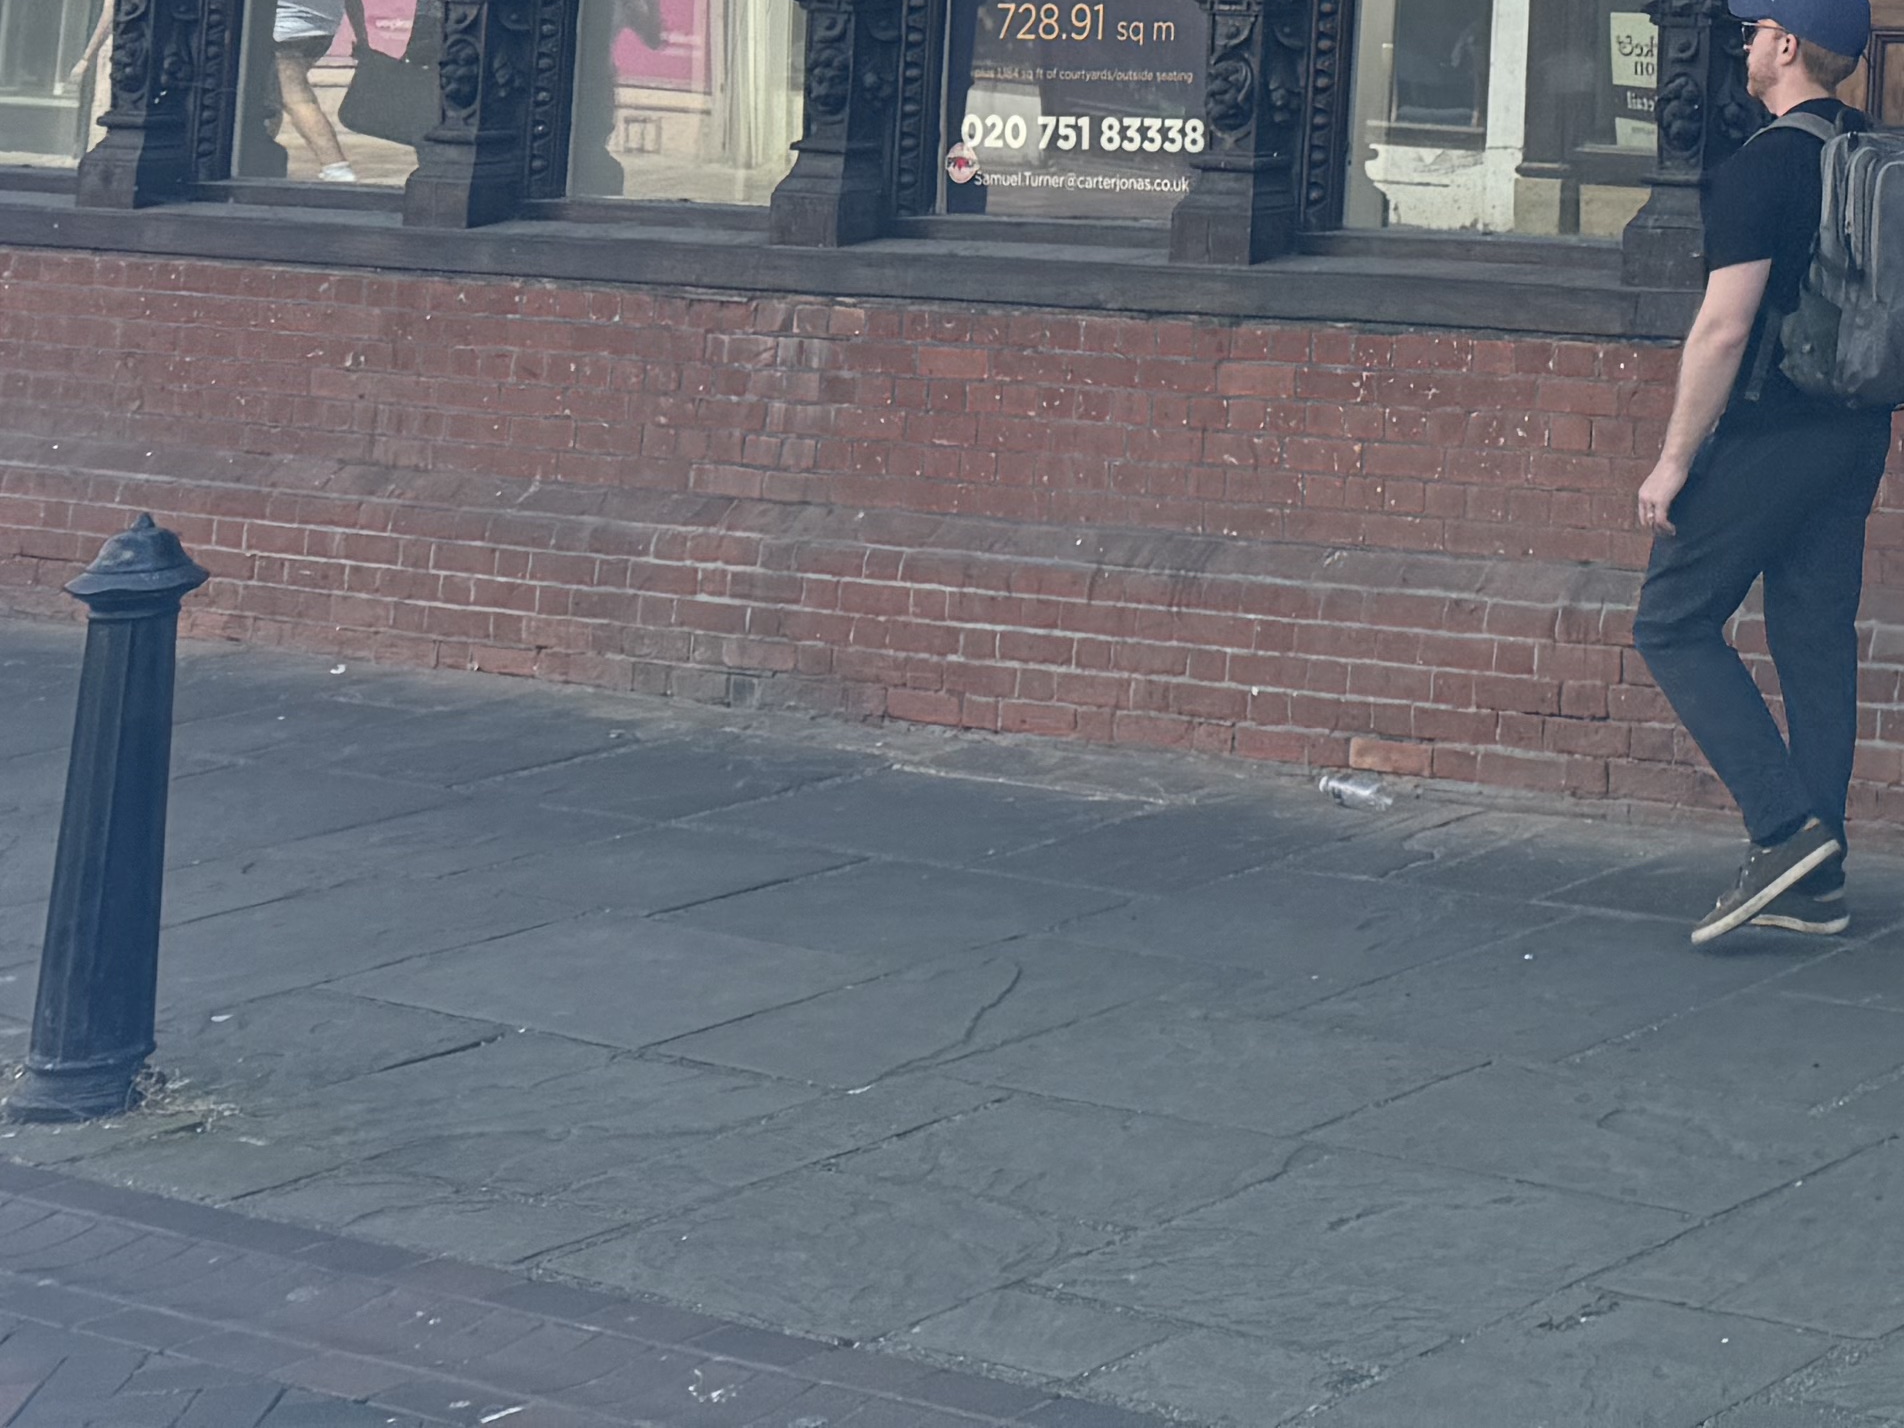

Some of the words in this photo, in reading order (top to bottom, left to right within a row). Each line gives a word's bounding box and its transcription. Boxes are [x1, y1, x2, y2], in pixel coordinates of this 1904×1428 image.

[997, 2, 1104, 40] 728.91
[1116, 20, 1145, 46] sq
[1153, 22, 1175, 41] m
[961, 113, 1027, 149] 020
[1038, 115, 1090, 151] 751
[1099, 116, 1206, 154] 83338
[973, 170, 1190, 194] Samuel.Turner@carterjonas.co.uk
